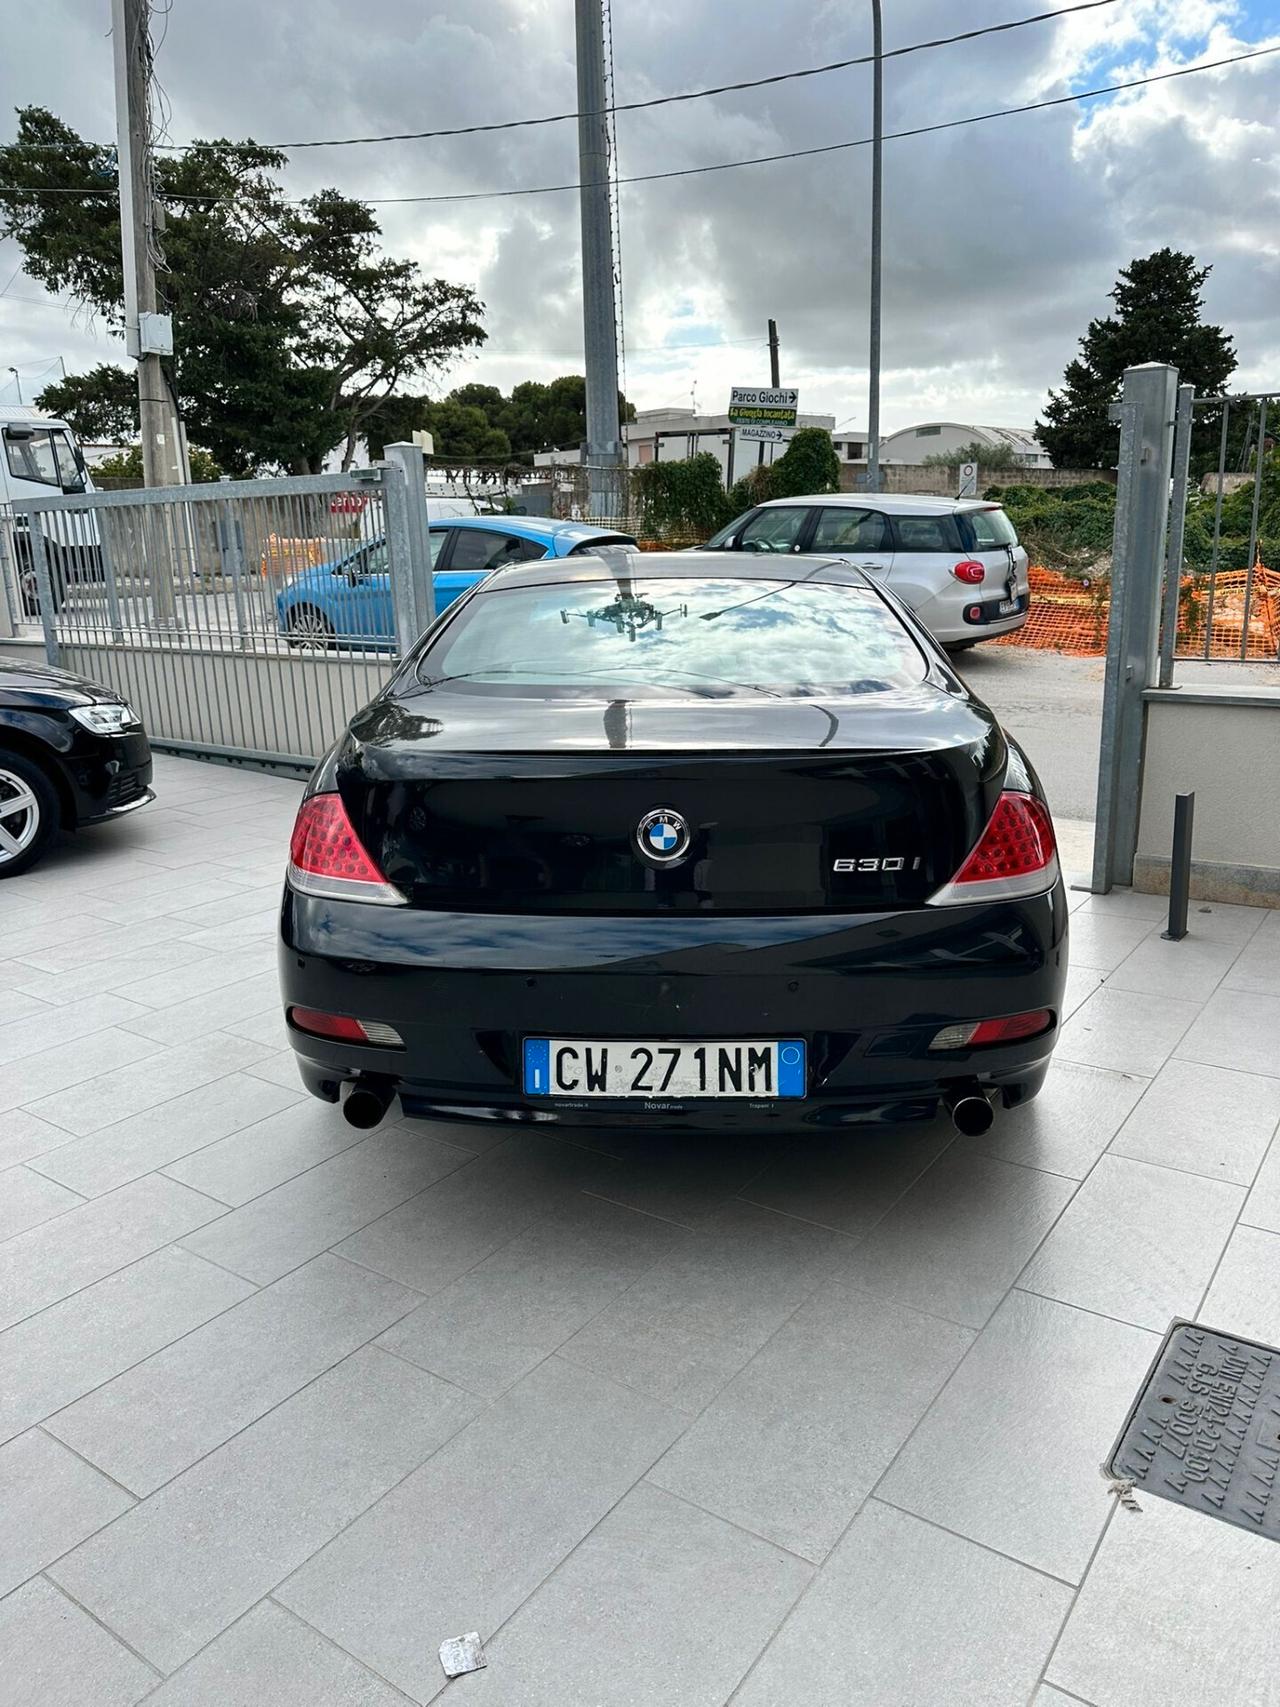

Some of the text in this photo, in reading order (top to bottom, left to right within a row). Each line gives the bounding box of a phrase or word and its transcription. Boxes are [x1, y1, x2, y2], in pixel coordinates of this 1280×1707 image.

[732, 390, 788, 404] Parco Giochi
[742, 429, 776, 438] MAGAZZINO
[645, 815, 682, 830] BMW
[556, 1047, 608, 1092] CW
[1187, 1362, 1219, 1396] GJS
[1219, 1357, 1249, 1383] UNI
